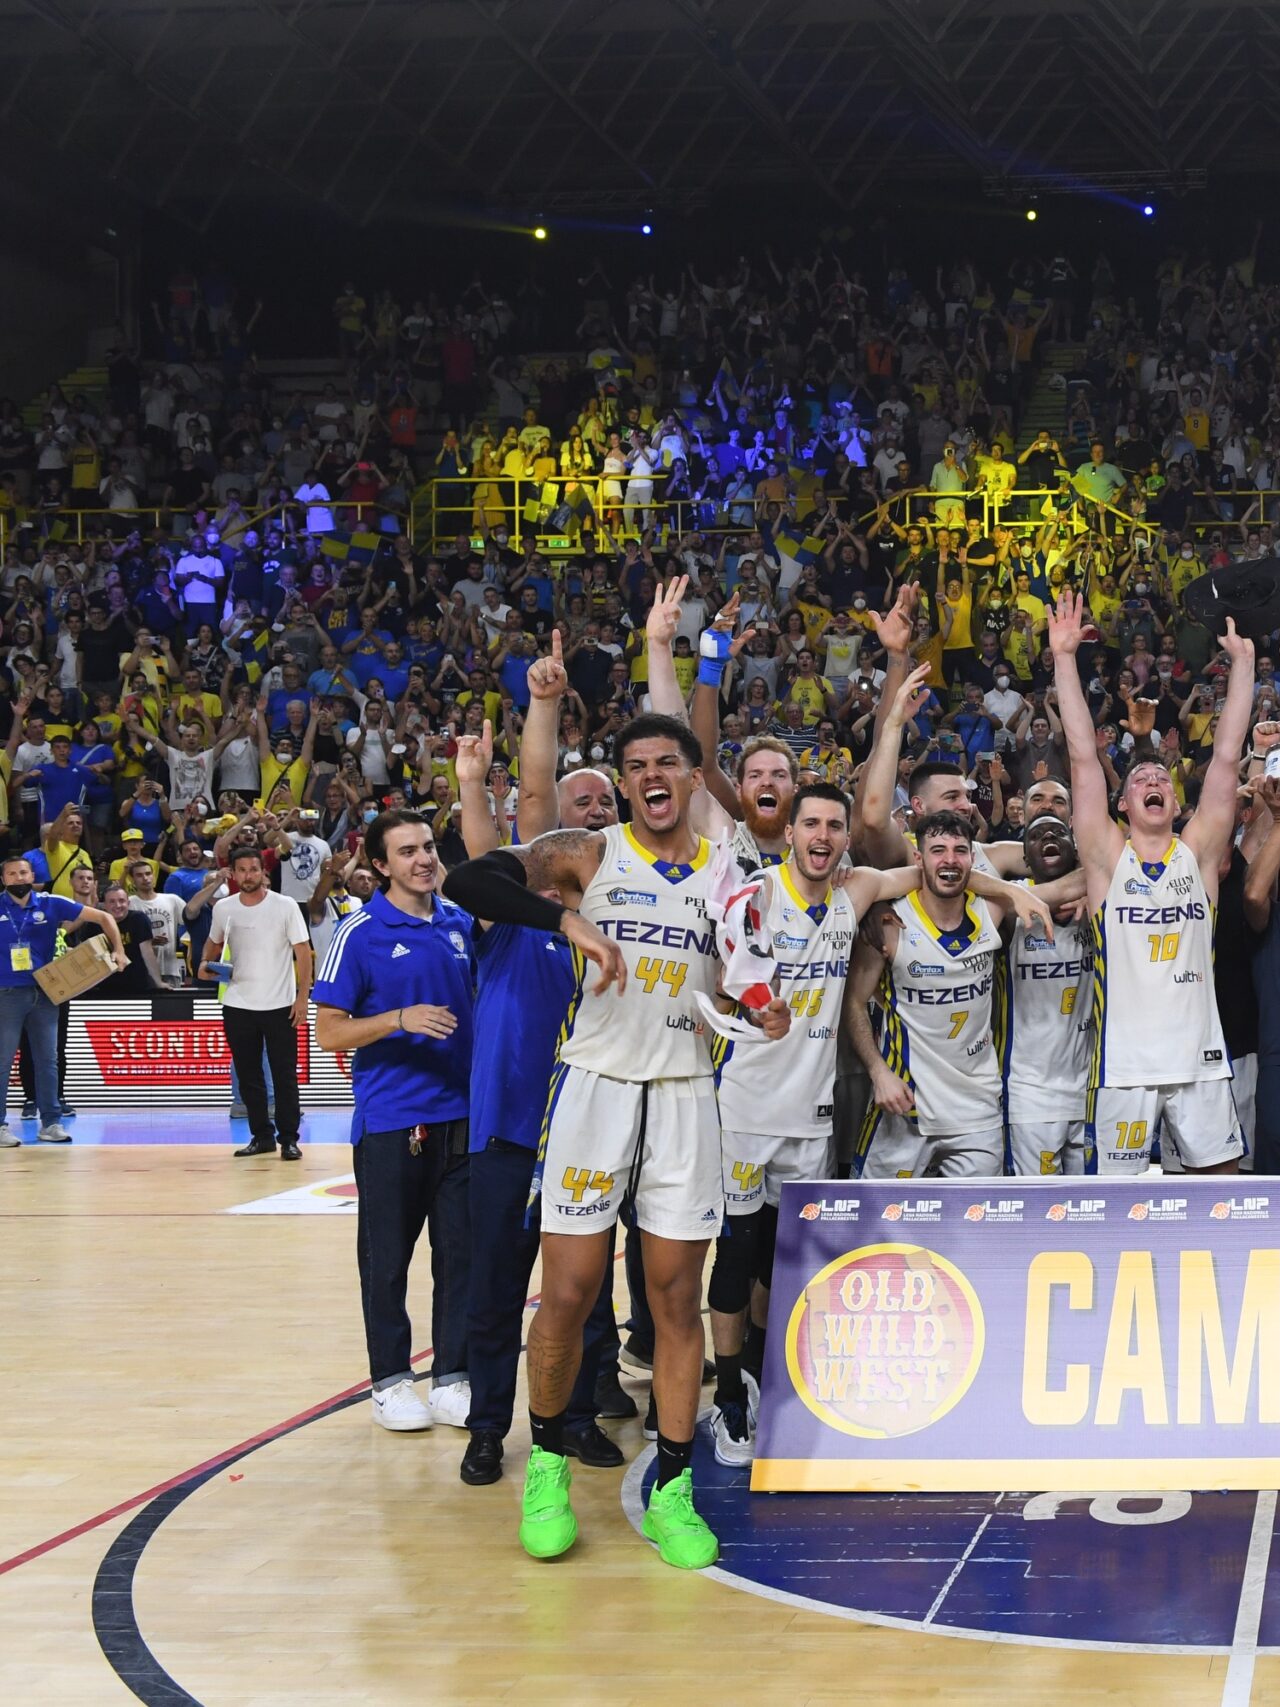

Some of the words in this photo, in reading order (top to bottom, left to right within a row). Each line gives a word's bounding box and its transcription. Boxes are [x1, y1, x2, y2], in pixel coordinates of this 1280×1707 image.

[616, 892, 656, 903] Pentax
[1148, 932, 1181, 962] 10
[635, 957, 688, 998] 44
[913, 965, 944, 974] Pentax
[789, 988, 825, 1018] 45
[947, 1011, 969, 1040] 7
[110, 1030, 225, 1059] SCONTO
[1116, 1120, 1148, 1149] 10
[822, 1200, 860, 1211] LNP
[904, 1200, 942, 1212] LNP
[986, 1200, 1024, 1212] LNP
[1067, 1200, 1105, 1212] LNP
[1149, 1199, 1187, 1211] LNP
[1231, 1198, 1269, 1210] LNP
[839, 1269, 936, 1313] OLD
[824, 1314, 945, 1358] WILD
[814, 1359, 950, 1403] WEST
